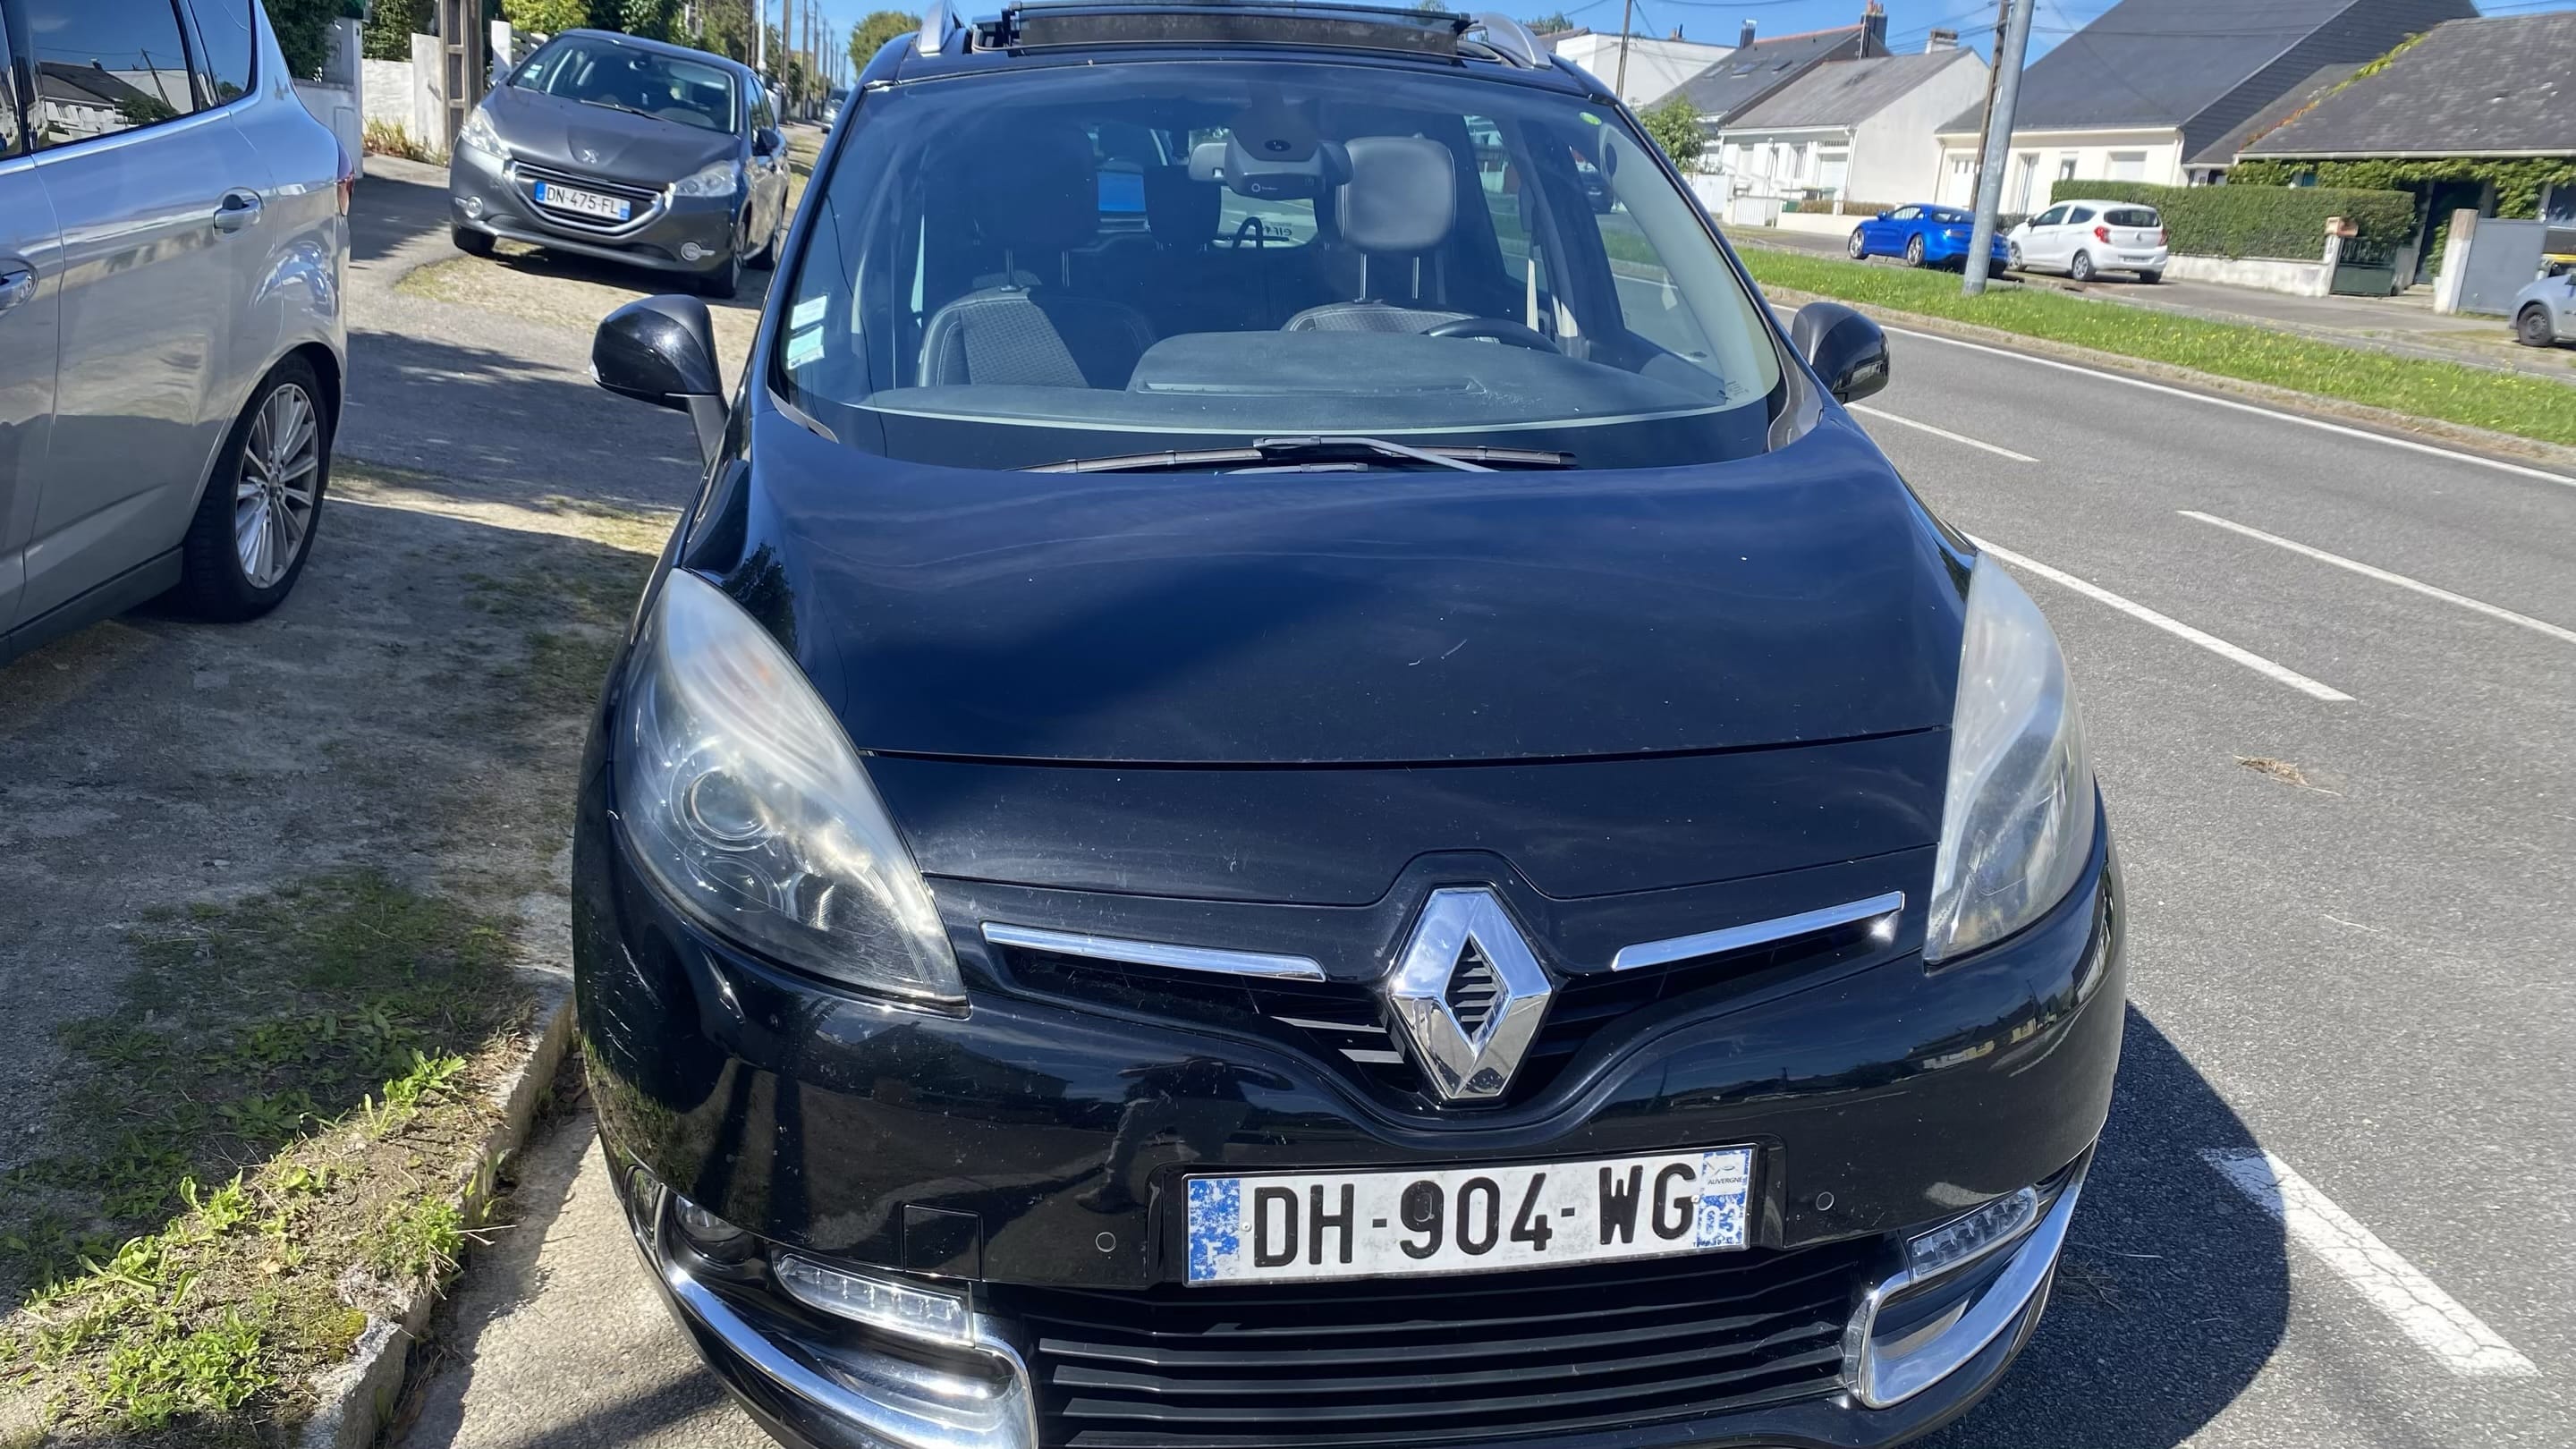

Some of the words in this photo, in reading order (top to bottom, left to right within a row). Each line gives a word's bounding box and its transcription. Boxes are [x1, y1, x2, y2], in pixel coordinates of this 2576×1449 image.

[547, 187, 619, 215] DN-475-FL
[1707, 1176, 1743, 1185] AUVERGNE
[1254, 1163, 1697, 1268] DH-904-WG
[1701, 1203, 1741, 1238] 03
